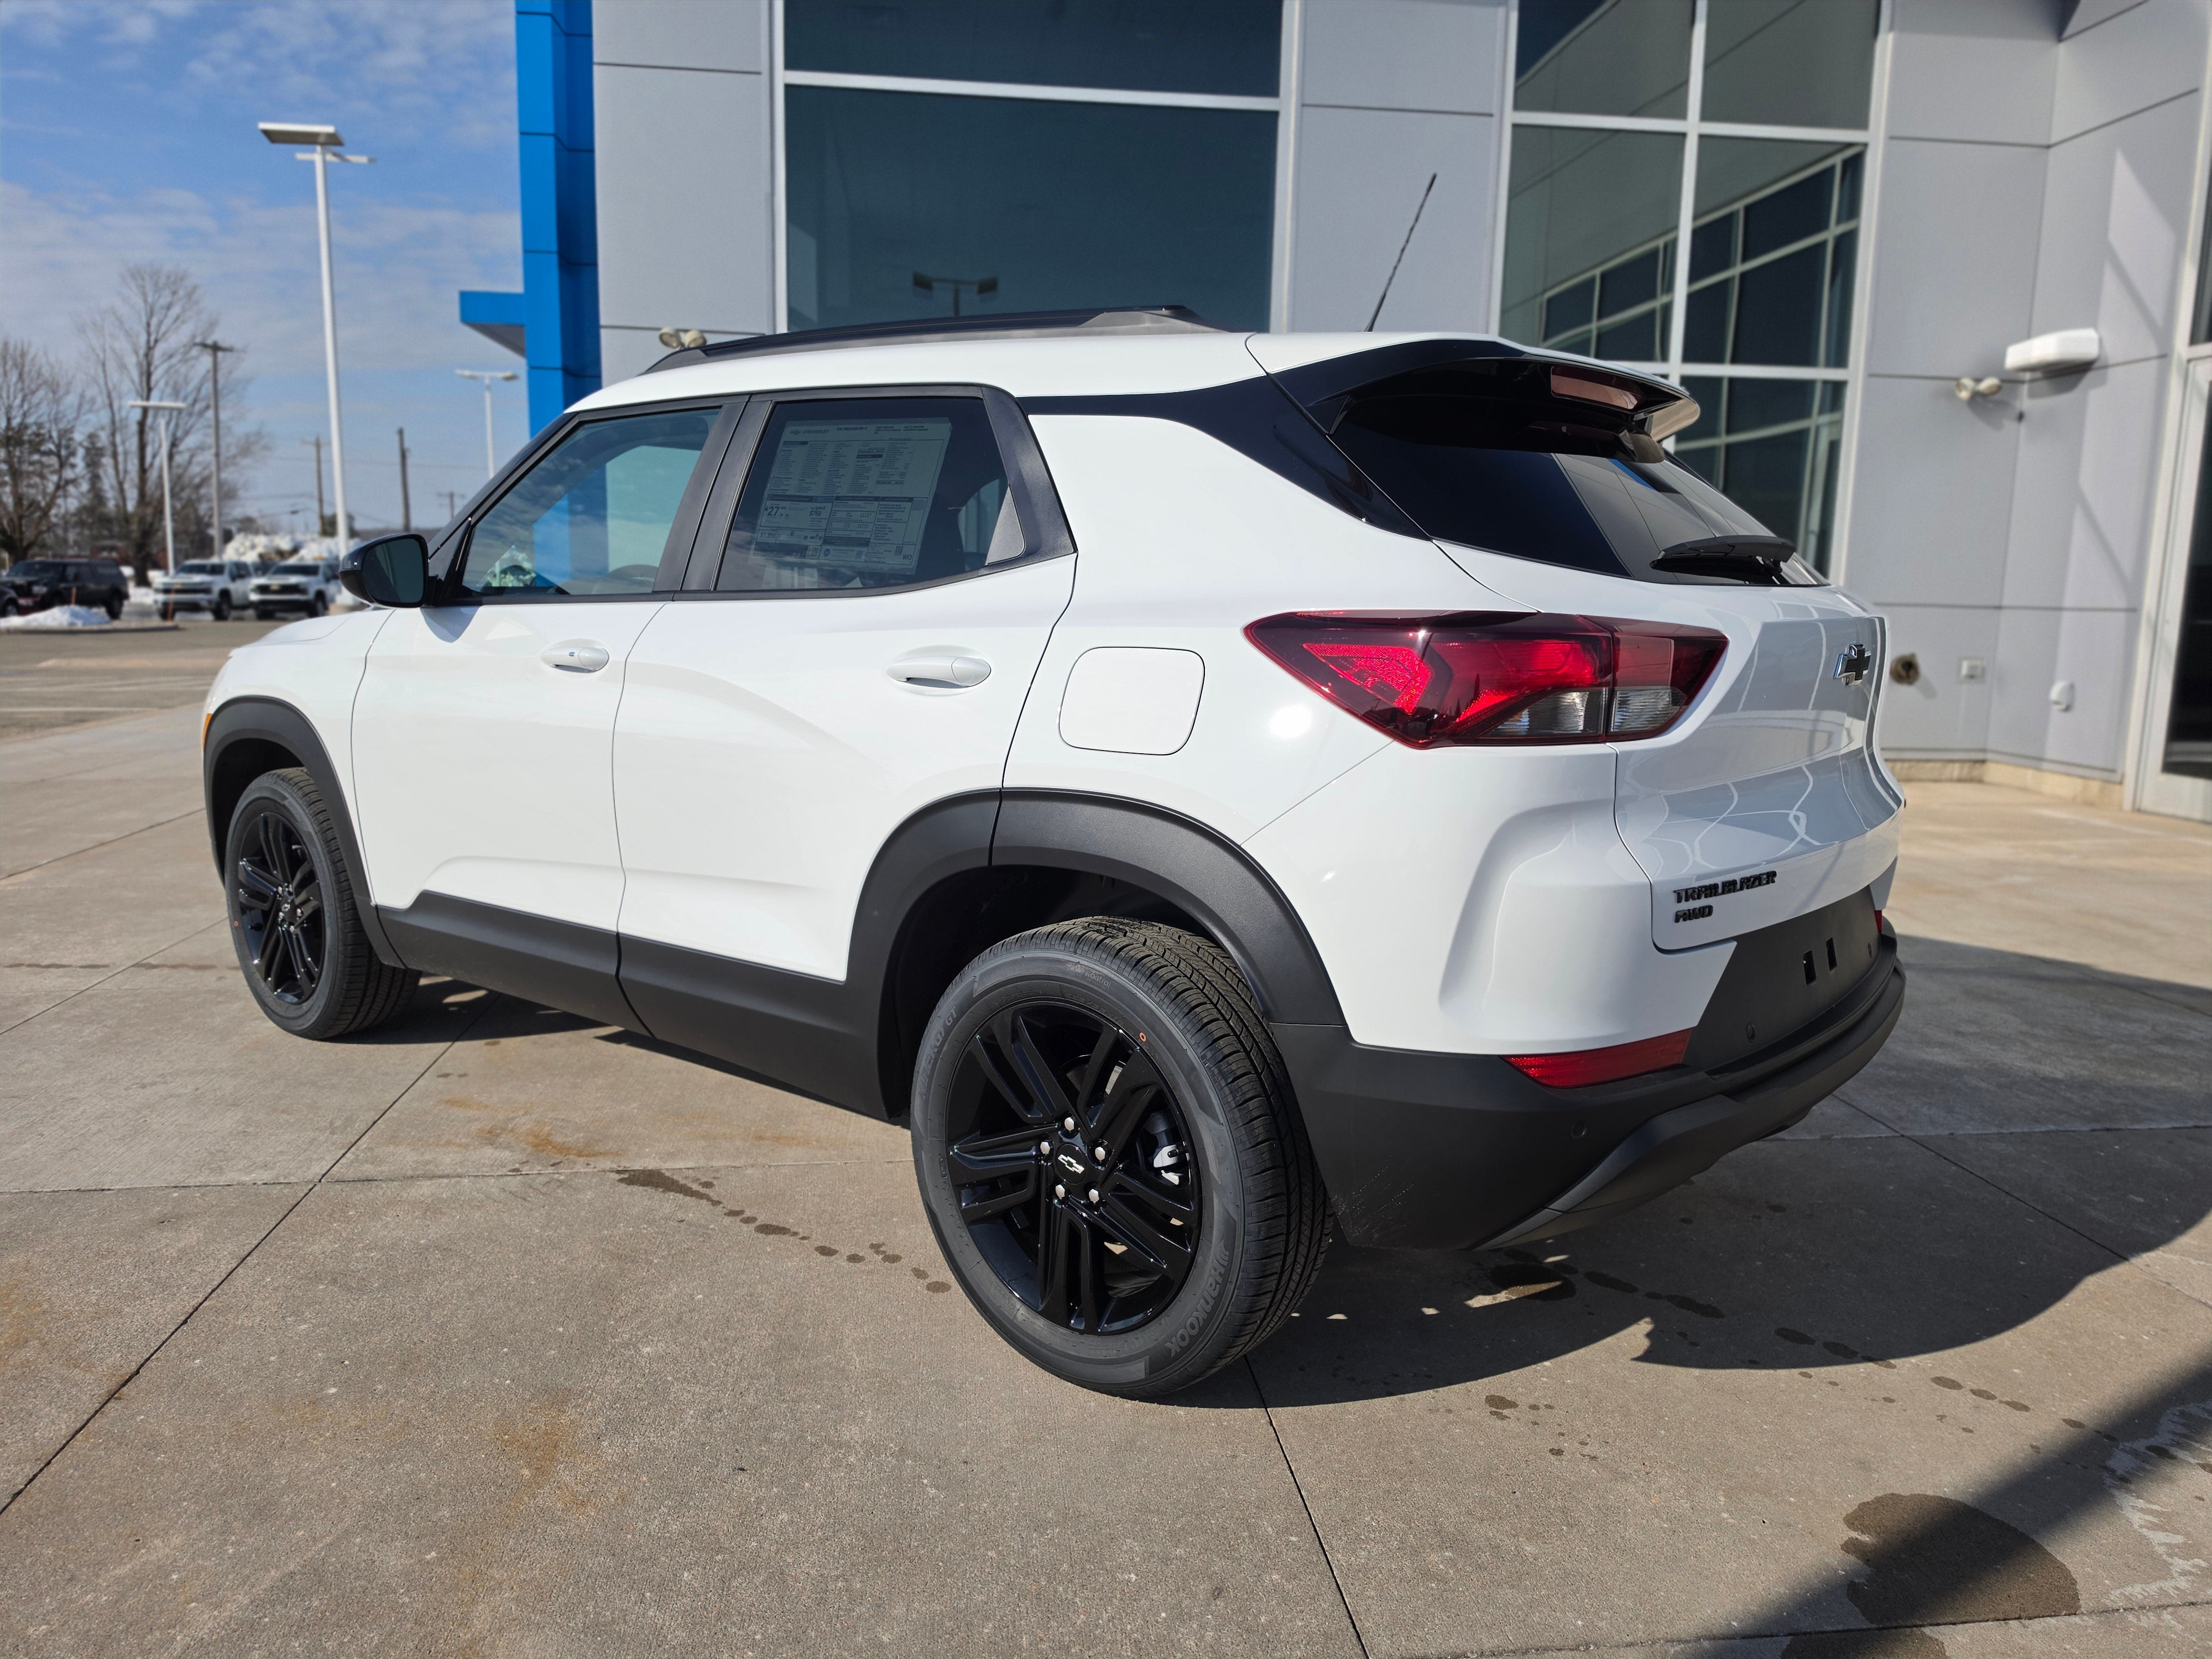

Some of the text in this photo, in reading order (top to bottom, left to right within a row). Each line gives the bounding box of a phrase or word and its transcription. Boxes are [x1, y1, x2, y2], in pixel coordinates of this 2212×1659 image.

[767, 506, 780, 517] 27
[1673, 870, 1777, 904] TRAILBLAZER
[1674, 905, 1713, 923] AWD
[945, 1006, 958, 1026] GT
